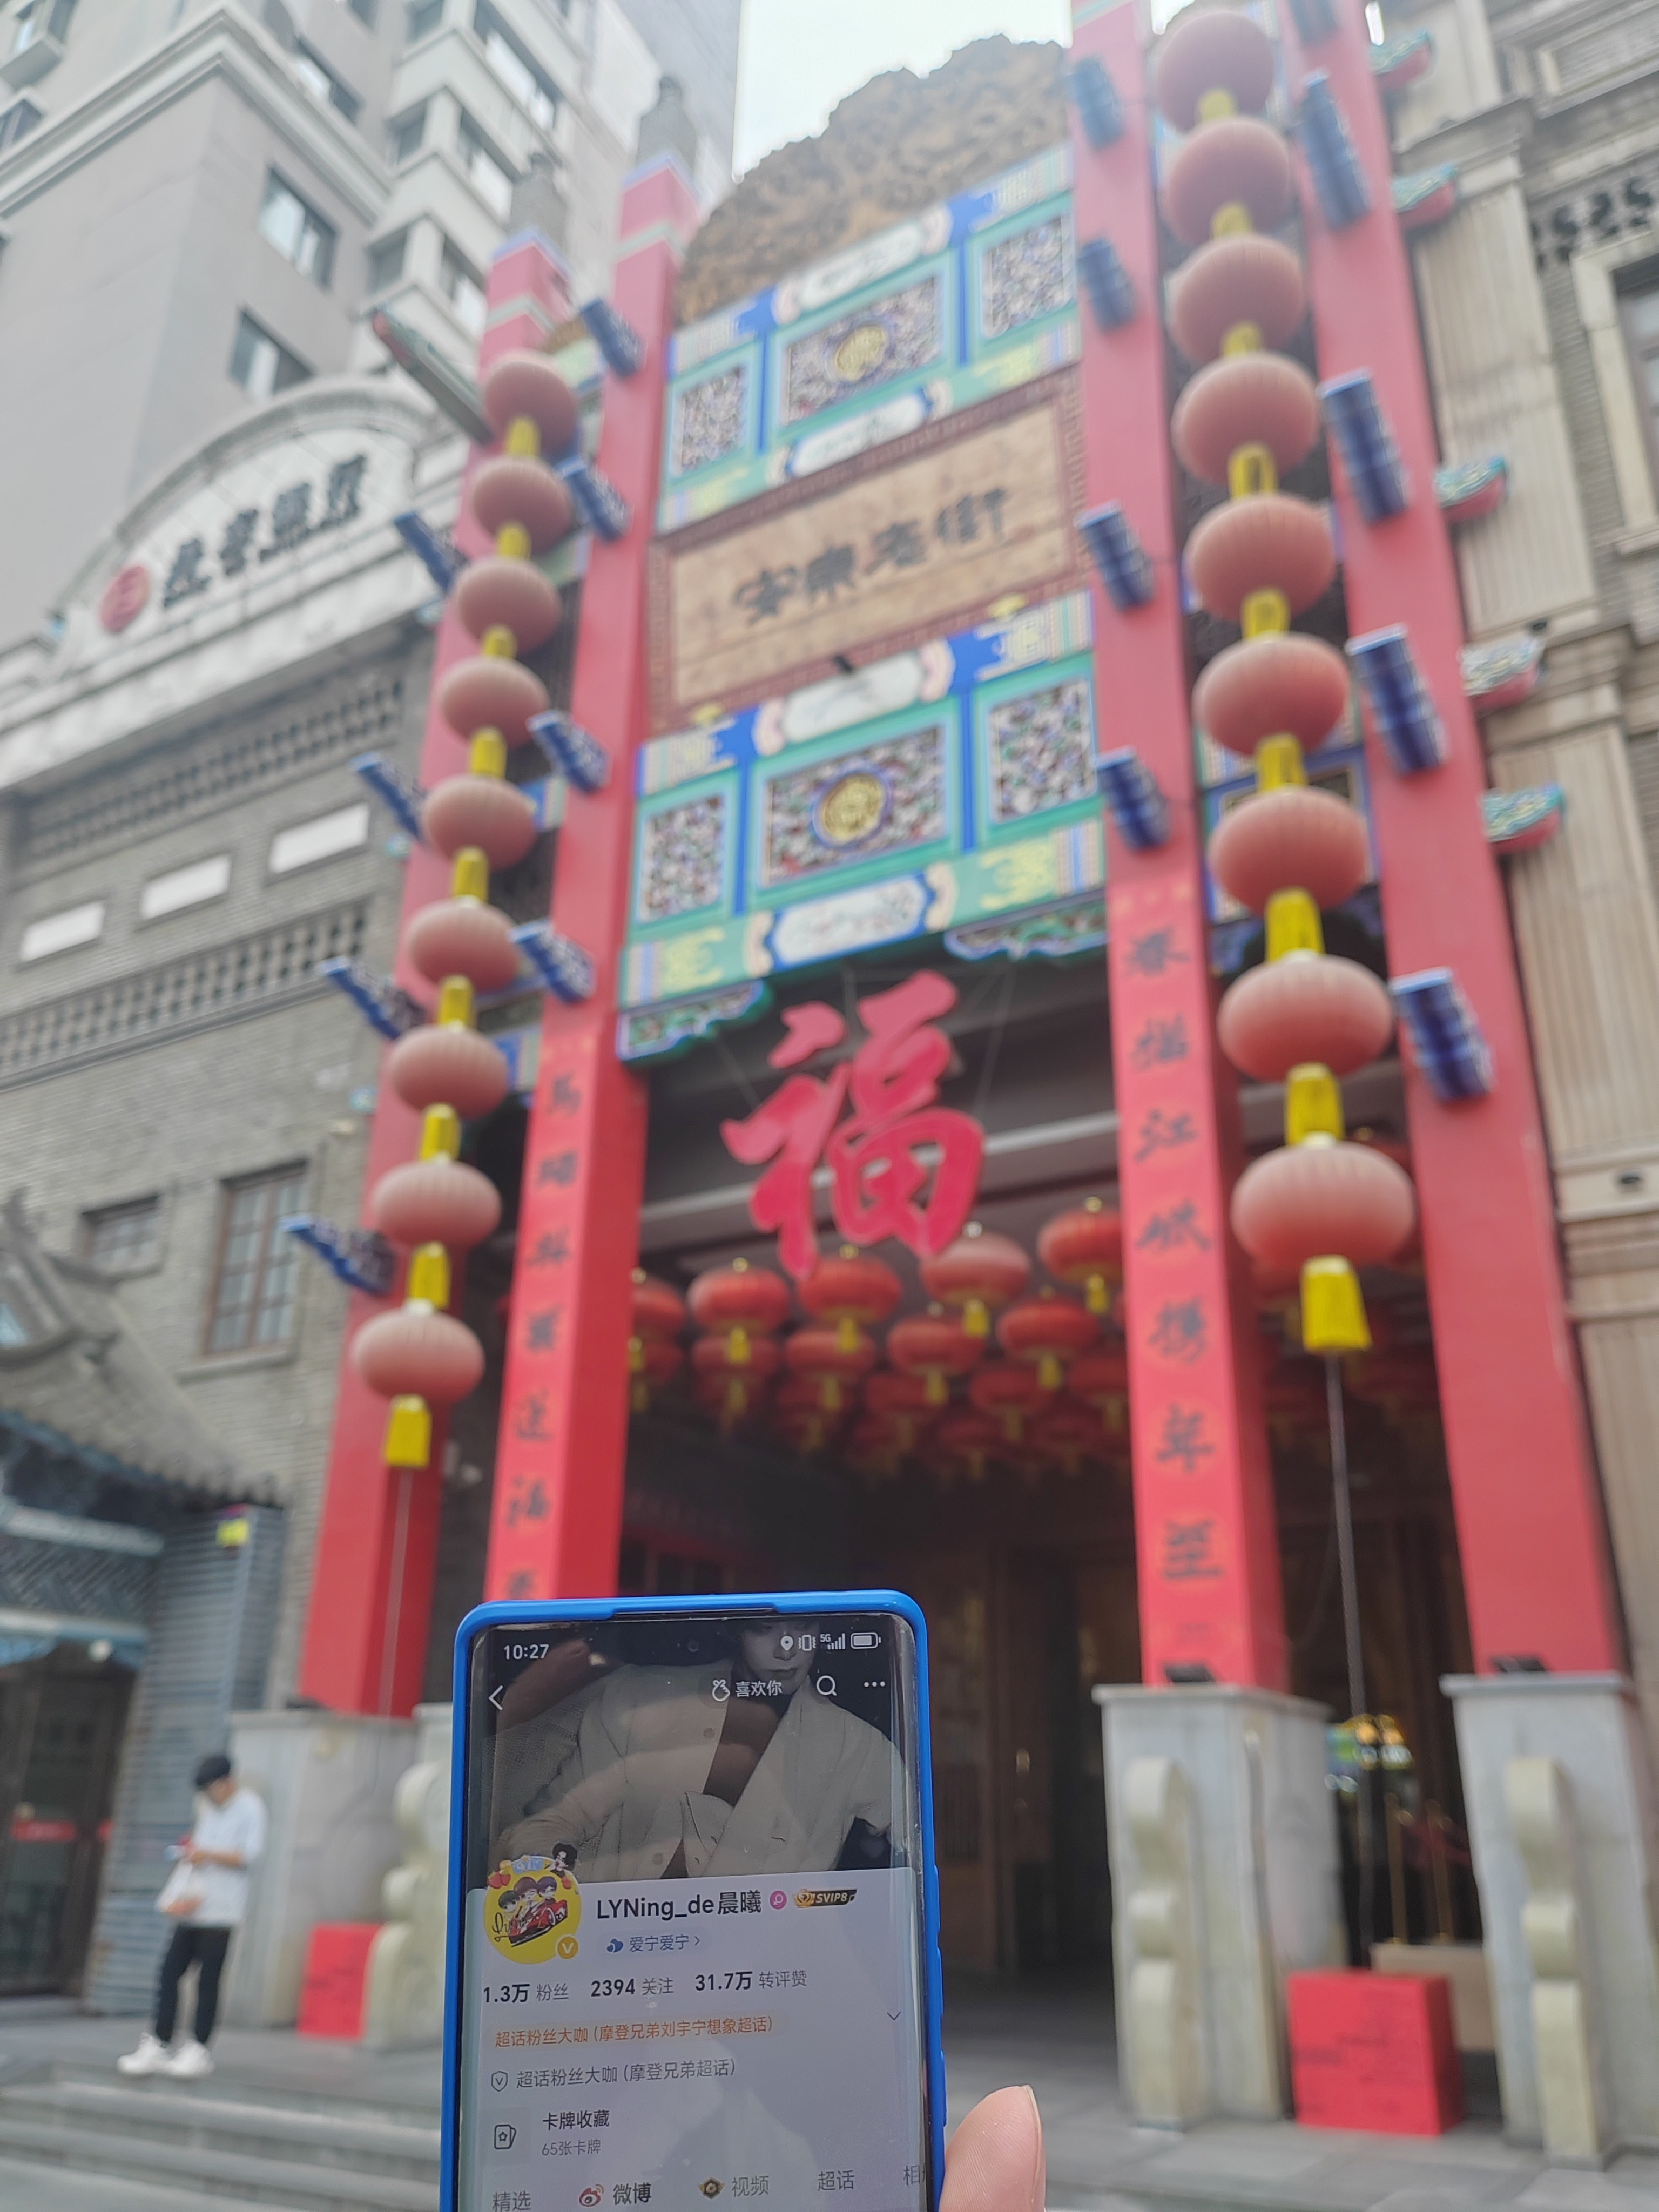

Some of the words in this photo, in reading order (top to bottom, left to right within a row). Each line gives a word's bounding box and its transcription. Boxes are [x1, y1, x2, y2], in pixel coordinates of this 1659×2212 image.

[720, 969, 984, 1281] 福
[820, 1634, 831, 1642] 5G
[503, 1644, 550, 1661] 10:27
[735, 1679, 783, 1698] 喜欢你
[815, 1891, 848, 1905] SVIP8
[629, 1934, 690, 1953] 爱宁爱宁
[483, 1983, 530, 2004] 1.3万
[536, 1984, 569, 2001] 粉丝
[590, 1979, 636, 1997] 2394
[642, 1978, 675, 1995] 关注
[694, 1971, 753, 1992] 31.7万
[759, 1970, 807, 1988] 转评赞
[542, 2109, 610, 2131] 卡牌收藏
[542, 2139, 601, 2156] 65张卡牌
[818, 2170, 855, 2191] 超话
[903, 2164, 925, 2186] 相
[613, 2183, 651, 2205] 微博
[731, 2175, 769, 2197] 视频
[492, 2191, 531, 2212] 精选
